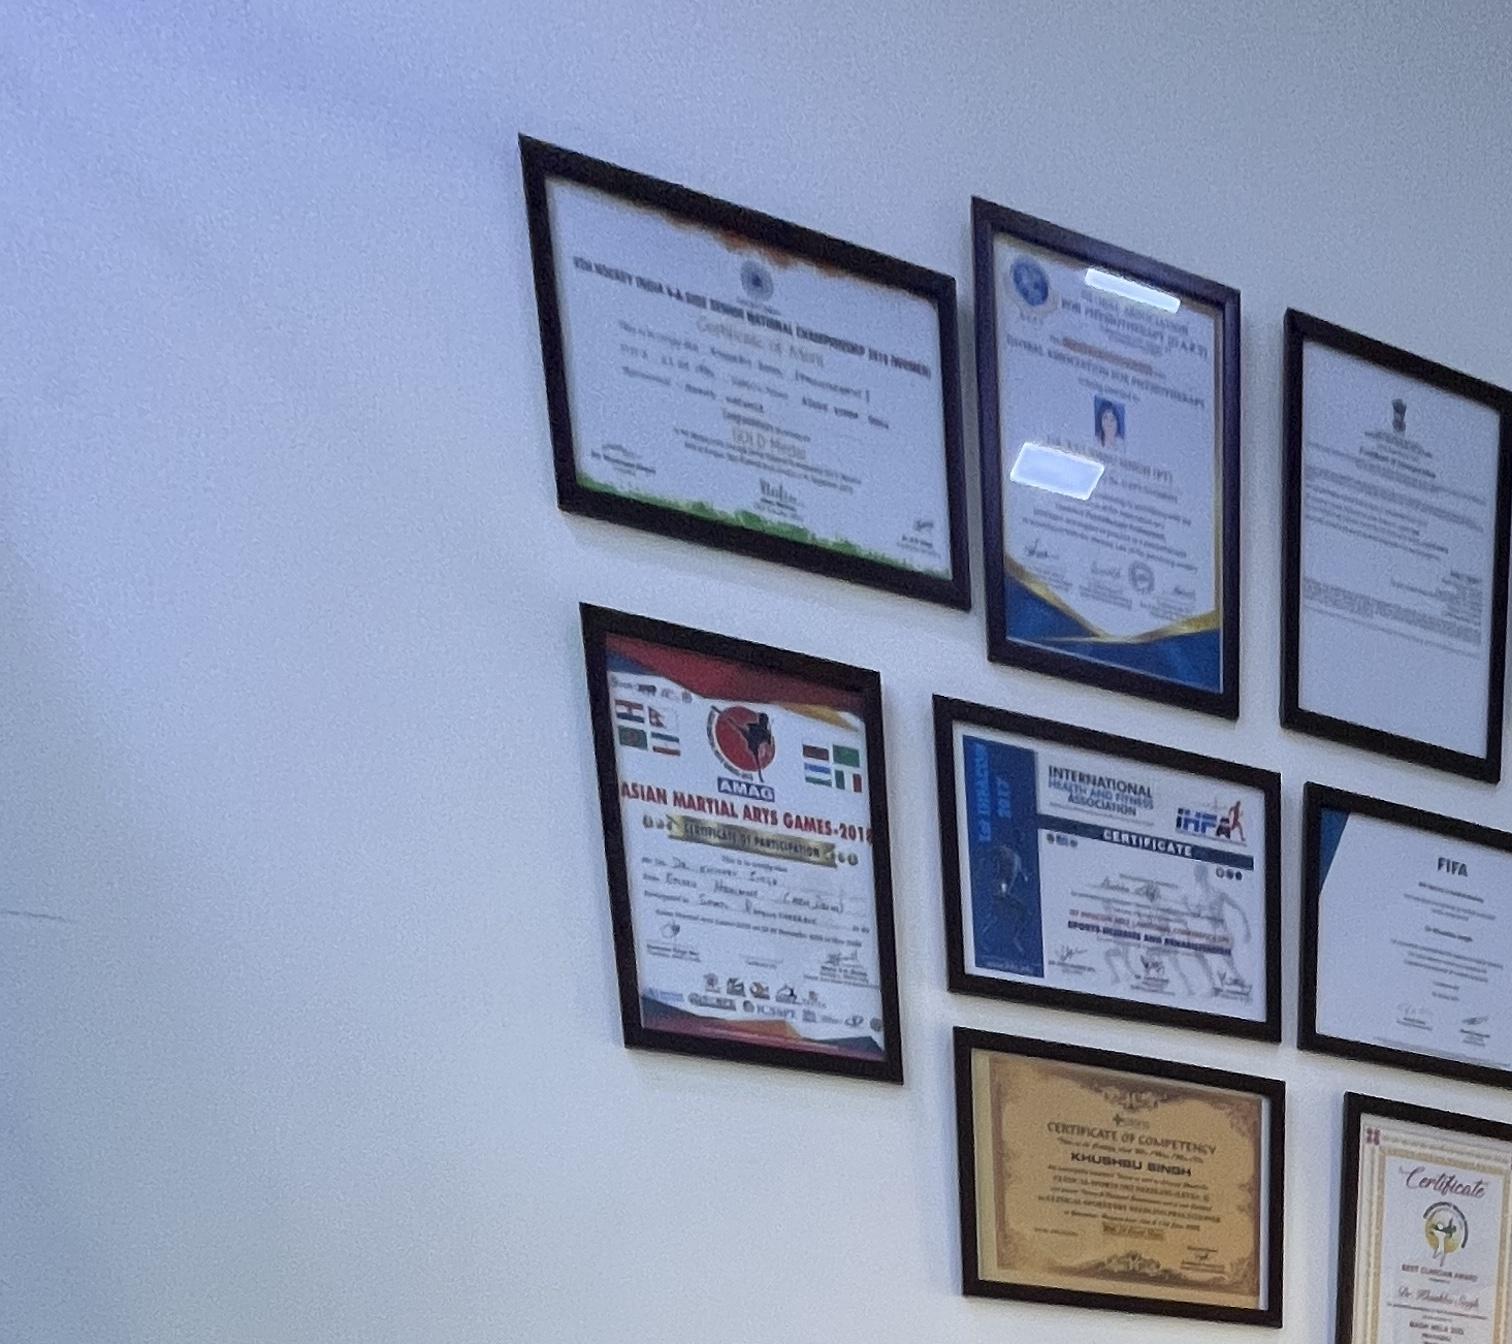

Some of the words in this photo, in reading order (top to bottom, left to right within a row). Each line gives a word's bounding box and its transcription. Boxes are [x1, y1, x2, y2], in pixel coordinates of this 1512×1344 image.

[719, 780, 774, 801] AMAG
[1048, 764, 1154, 799] INTERNATIONAL
[621, 783, 669, 806] ASIAN
[672, 790, 739, 819] MARTIAL
[742, 806, 779, 826] ARTS
[1067, 793, 1137, 818] ASSOCIATION
[1102, 827, 1193, 858] CERTIFICATE
[1437, 856, 1469, 878] FIFA
[1047, 1121, 1118, 1142] CERTIFICATE
[1120, 1131, 1136, 1145] OF
[1137, 1134, 1217, 1156] COMPETENCY
[1070, 1151, 1143, 1171] KHUSHBU
[1404, 1164, 1488, 1200] Certificate
